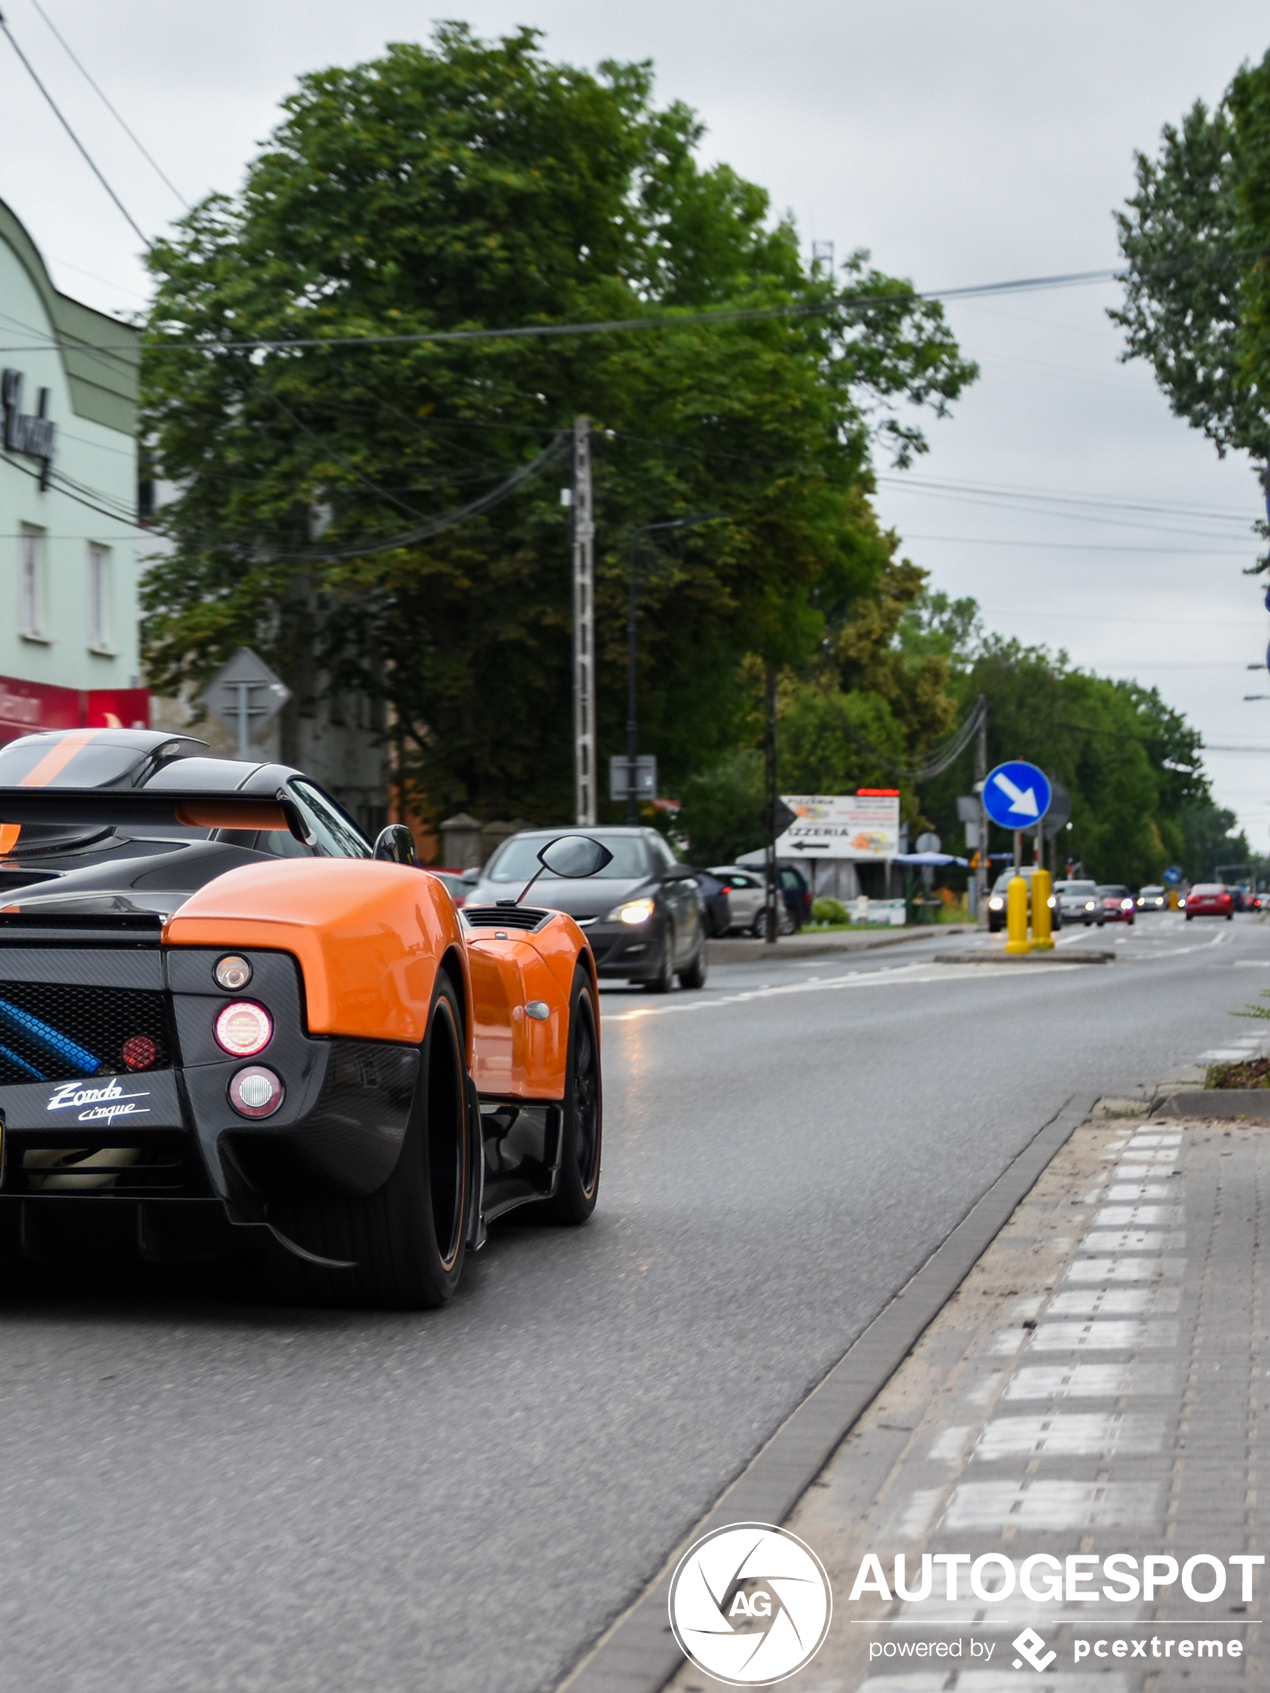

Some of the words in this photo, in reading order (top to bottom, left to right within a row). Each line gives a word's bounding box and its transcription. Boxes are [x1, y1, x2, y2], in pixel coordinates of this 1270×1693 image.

[787, 827, 849, 836] IZZERIA
[47, 1078, 150, 1110] Zonda
[78, 1103, 150, 1125] cinque
